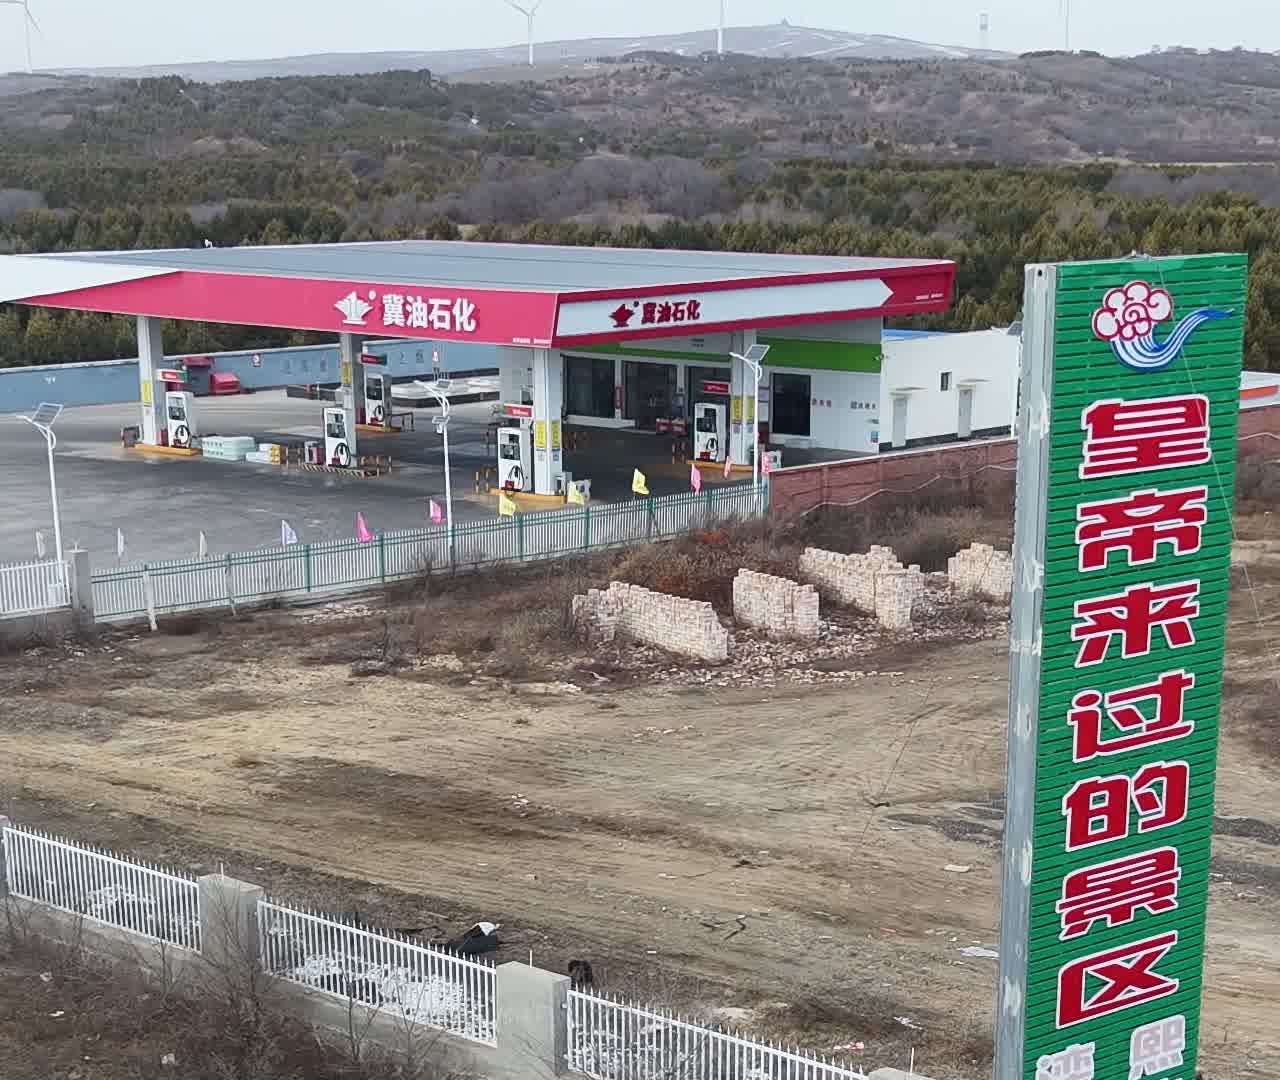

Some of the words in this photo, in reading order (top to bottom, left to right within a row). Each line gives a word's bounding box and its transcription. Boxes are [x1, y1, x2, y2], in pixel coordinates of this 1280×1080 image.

[1056, 393, 1212, 1029] 皇帝来过的景区
